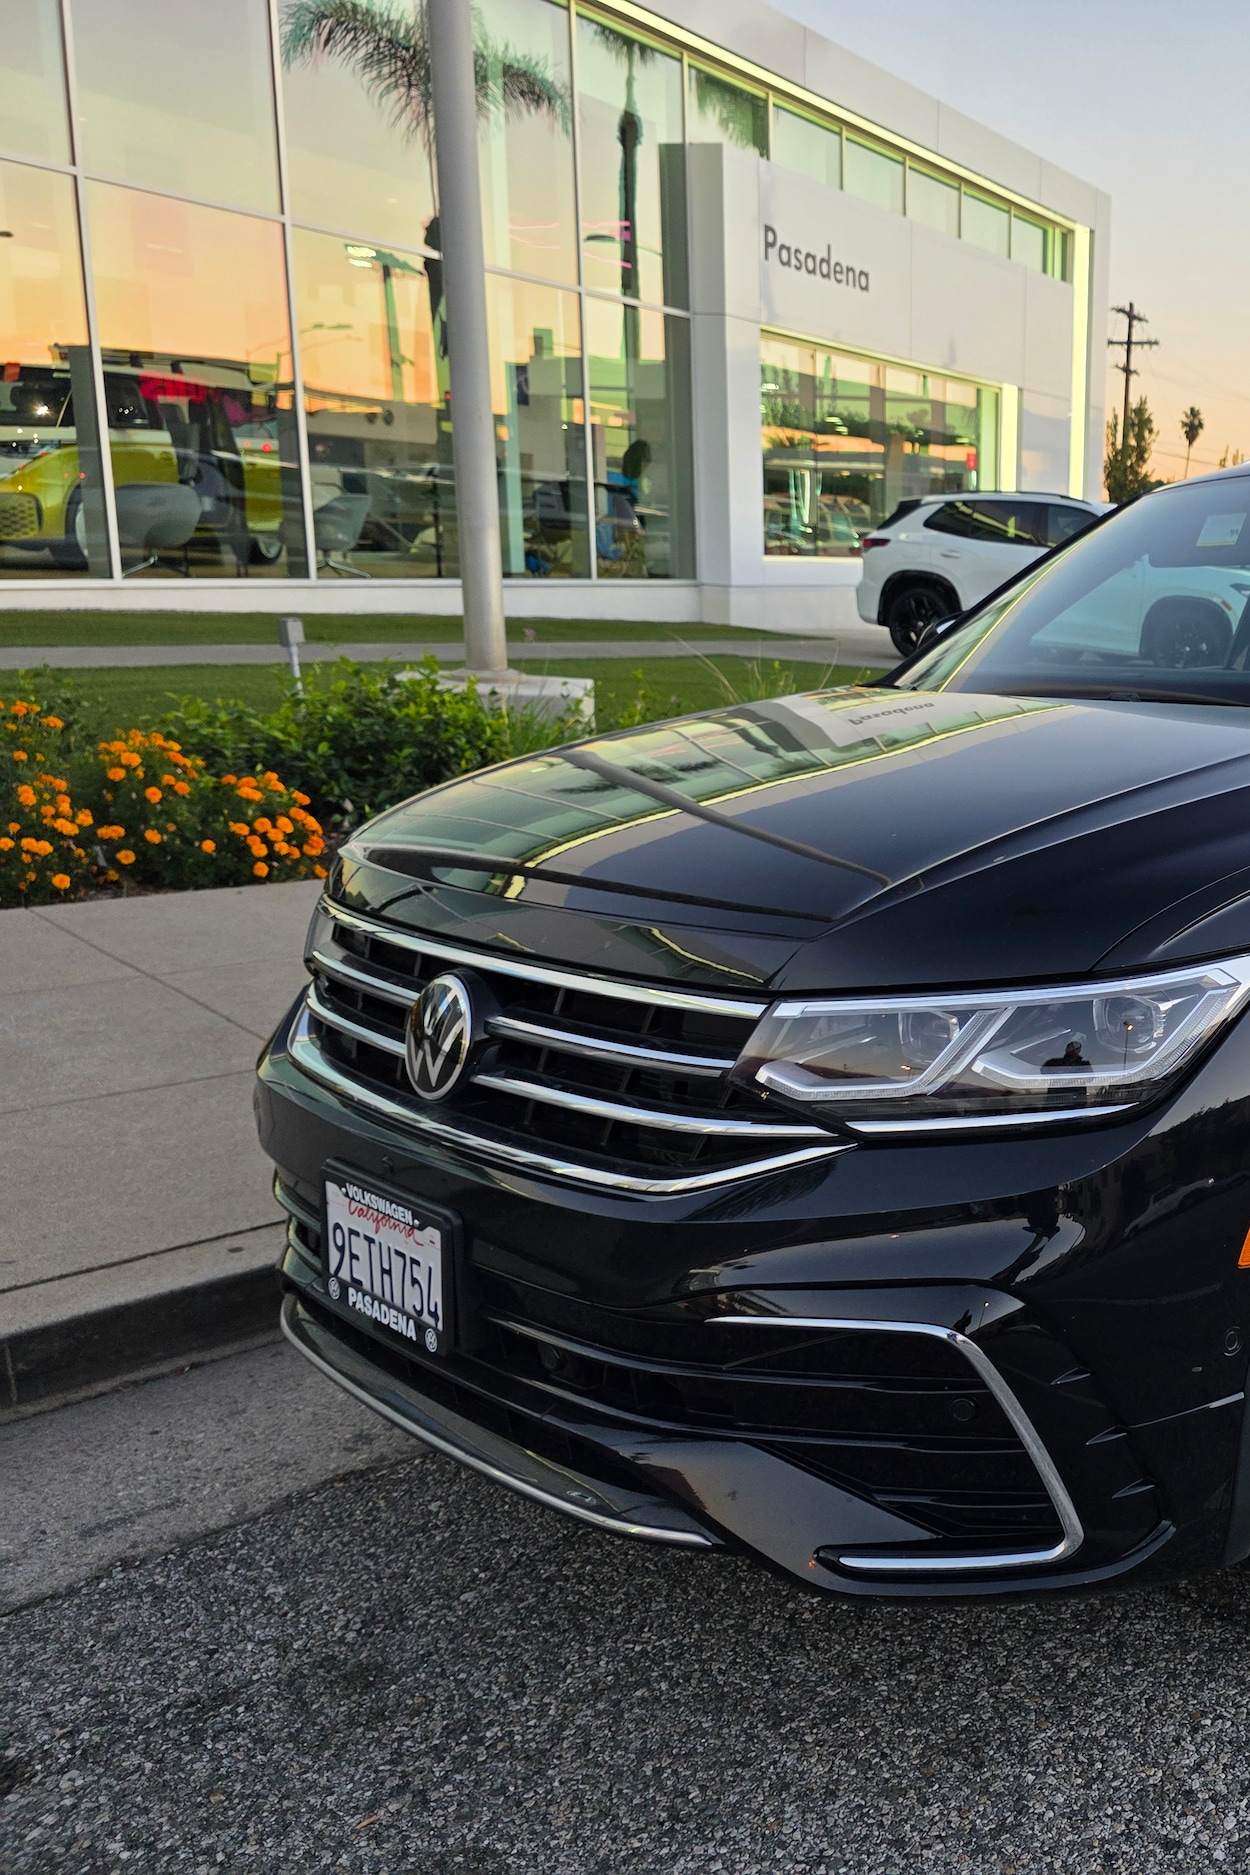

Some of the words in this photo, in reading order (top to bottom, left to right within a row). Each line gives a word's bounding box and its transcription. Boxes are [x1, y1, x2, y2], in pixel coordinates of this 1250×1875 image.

[763, 223, 870, 293] Pasadena
[405, 974, 472, 1100] VW
[345, 1183, 414, 1226] VOLKSWAGEN
[346, 1200, 424, 1247] California
[332, 1221, 440, 1330] 9ETH754
[347, 1286, 417, 1341] PASADENA
